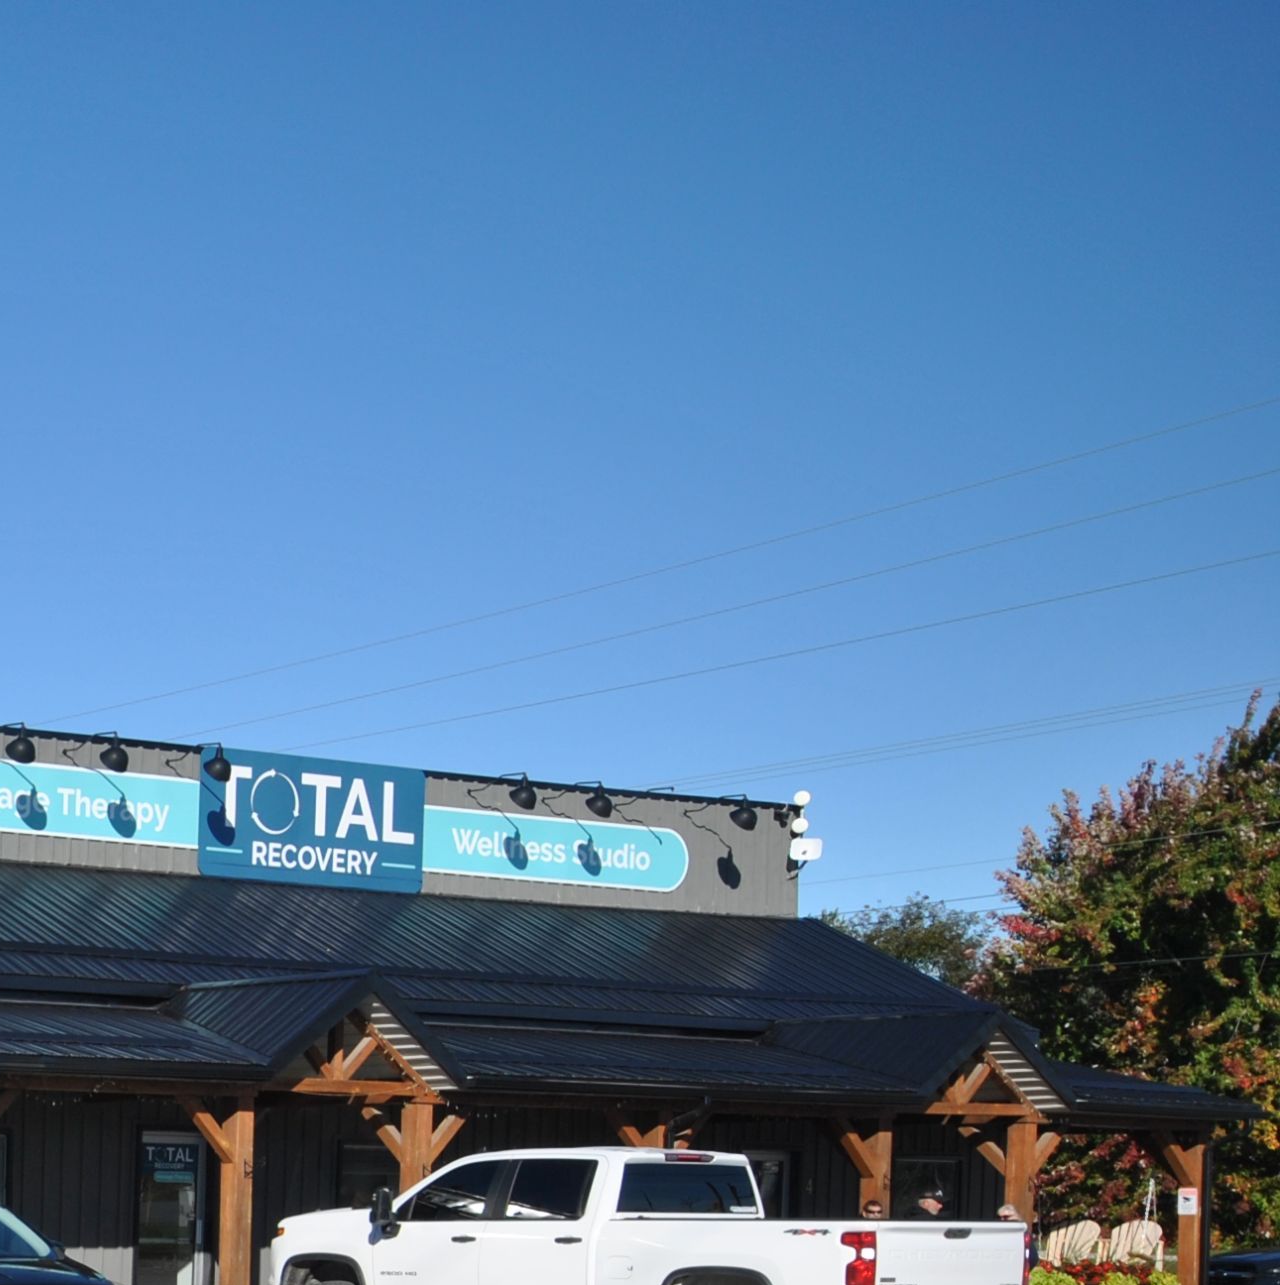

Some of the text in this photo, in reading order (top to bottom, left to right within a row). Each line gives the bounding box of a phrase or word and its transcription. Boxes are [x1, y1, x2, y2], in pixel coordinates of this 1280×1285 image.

[57, 787, 169, 832] Therapy
[252, 840, 378, 876] RECOVERY
[451, 828, 652, 871] Wellness Studio
